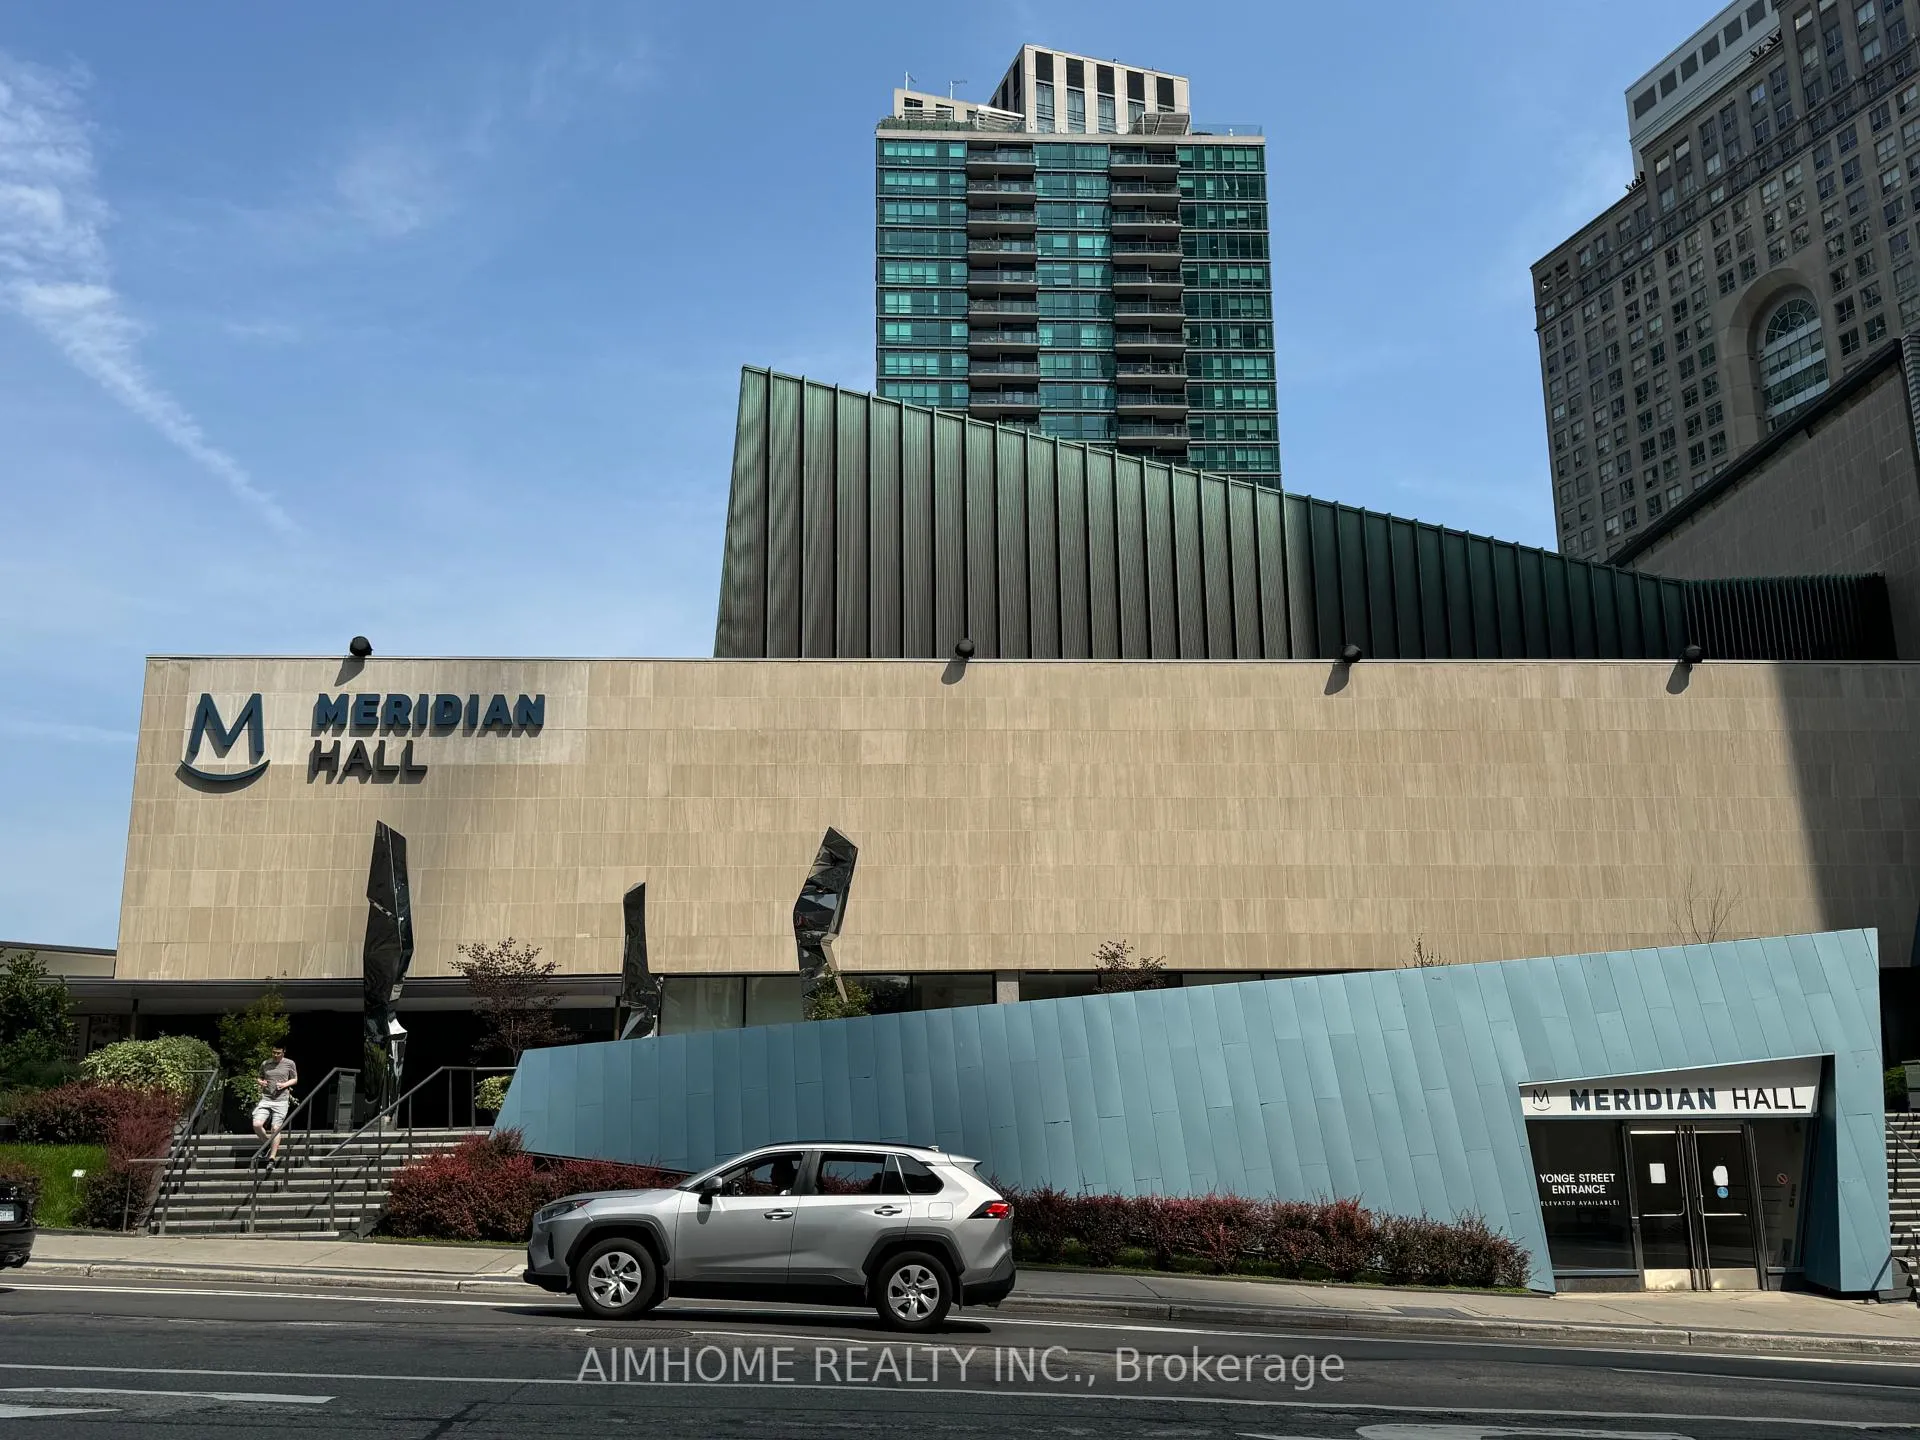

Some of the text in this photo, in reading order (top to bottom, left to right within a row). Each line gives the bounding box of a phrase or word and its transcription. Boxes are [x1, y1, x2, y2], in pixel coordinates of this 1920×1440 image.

[315, 692, 546, 727] MERIDIAN
[313, 739, 428, 773] HALL
[1569, 1087, 1807, 1111] MERIDIAN HALL
[1540, 1173, 1616, 1183] YONGE STREET
[1552, 1184, 1607, 1194] ENTRANCE
